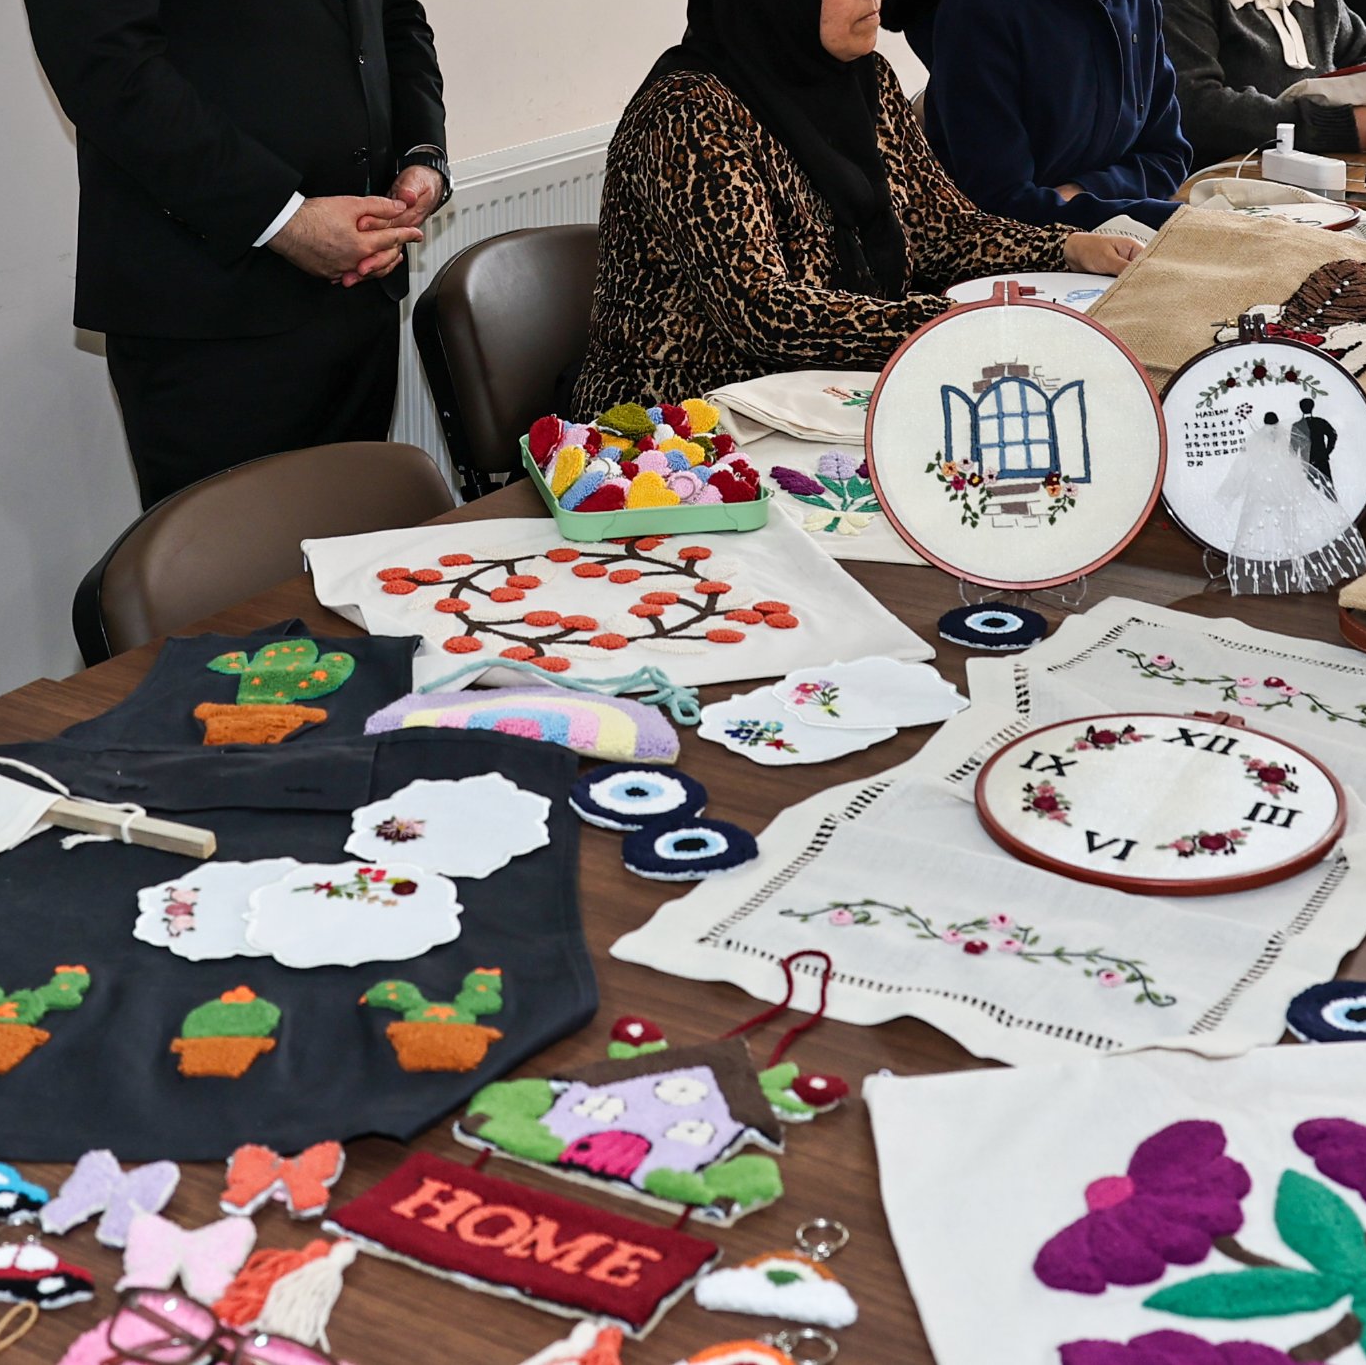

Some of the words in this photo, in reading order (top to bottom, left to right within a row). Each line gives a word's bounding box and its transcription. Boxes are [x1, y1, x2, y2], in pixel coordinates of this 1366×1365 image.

[1163, 727, 1239, 755] XII
[1019, 750, 1078, 777] IX
[1243, 801, 1303, 829] III
[1085, 830, 1139, 861] VI
[390, 1177, 665, 1288] HOME
